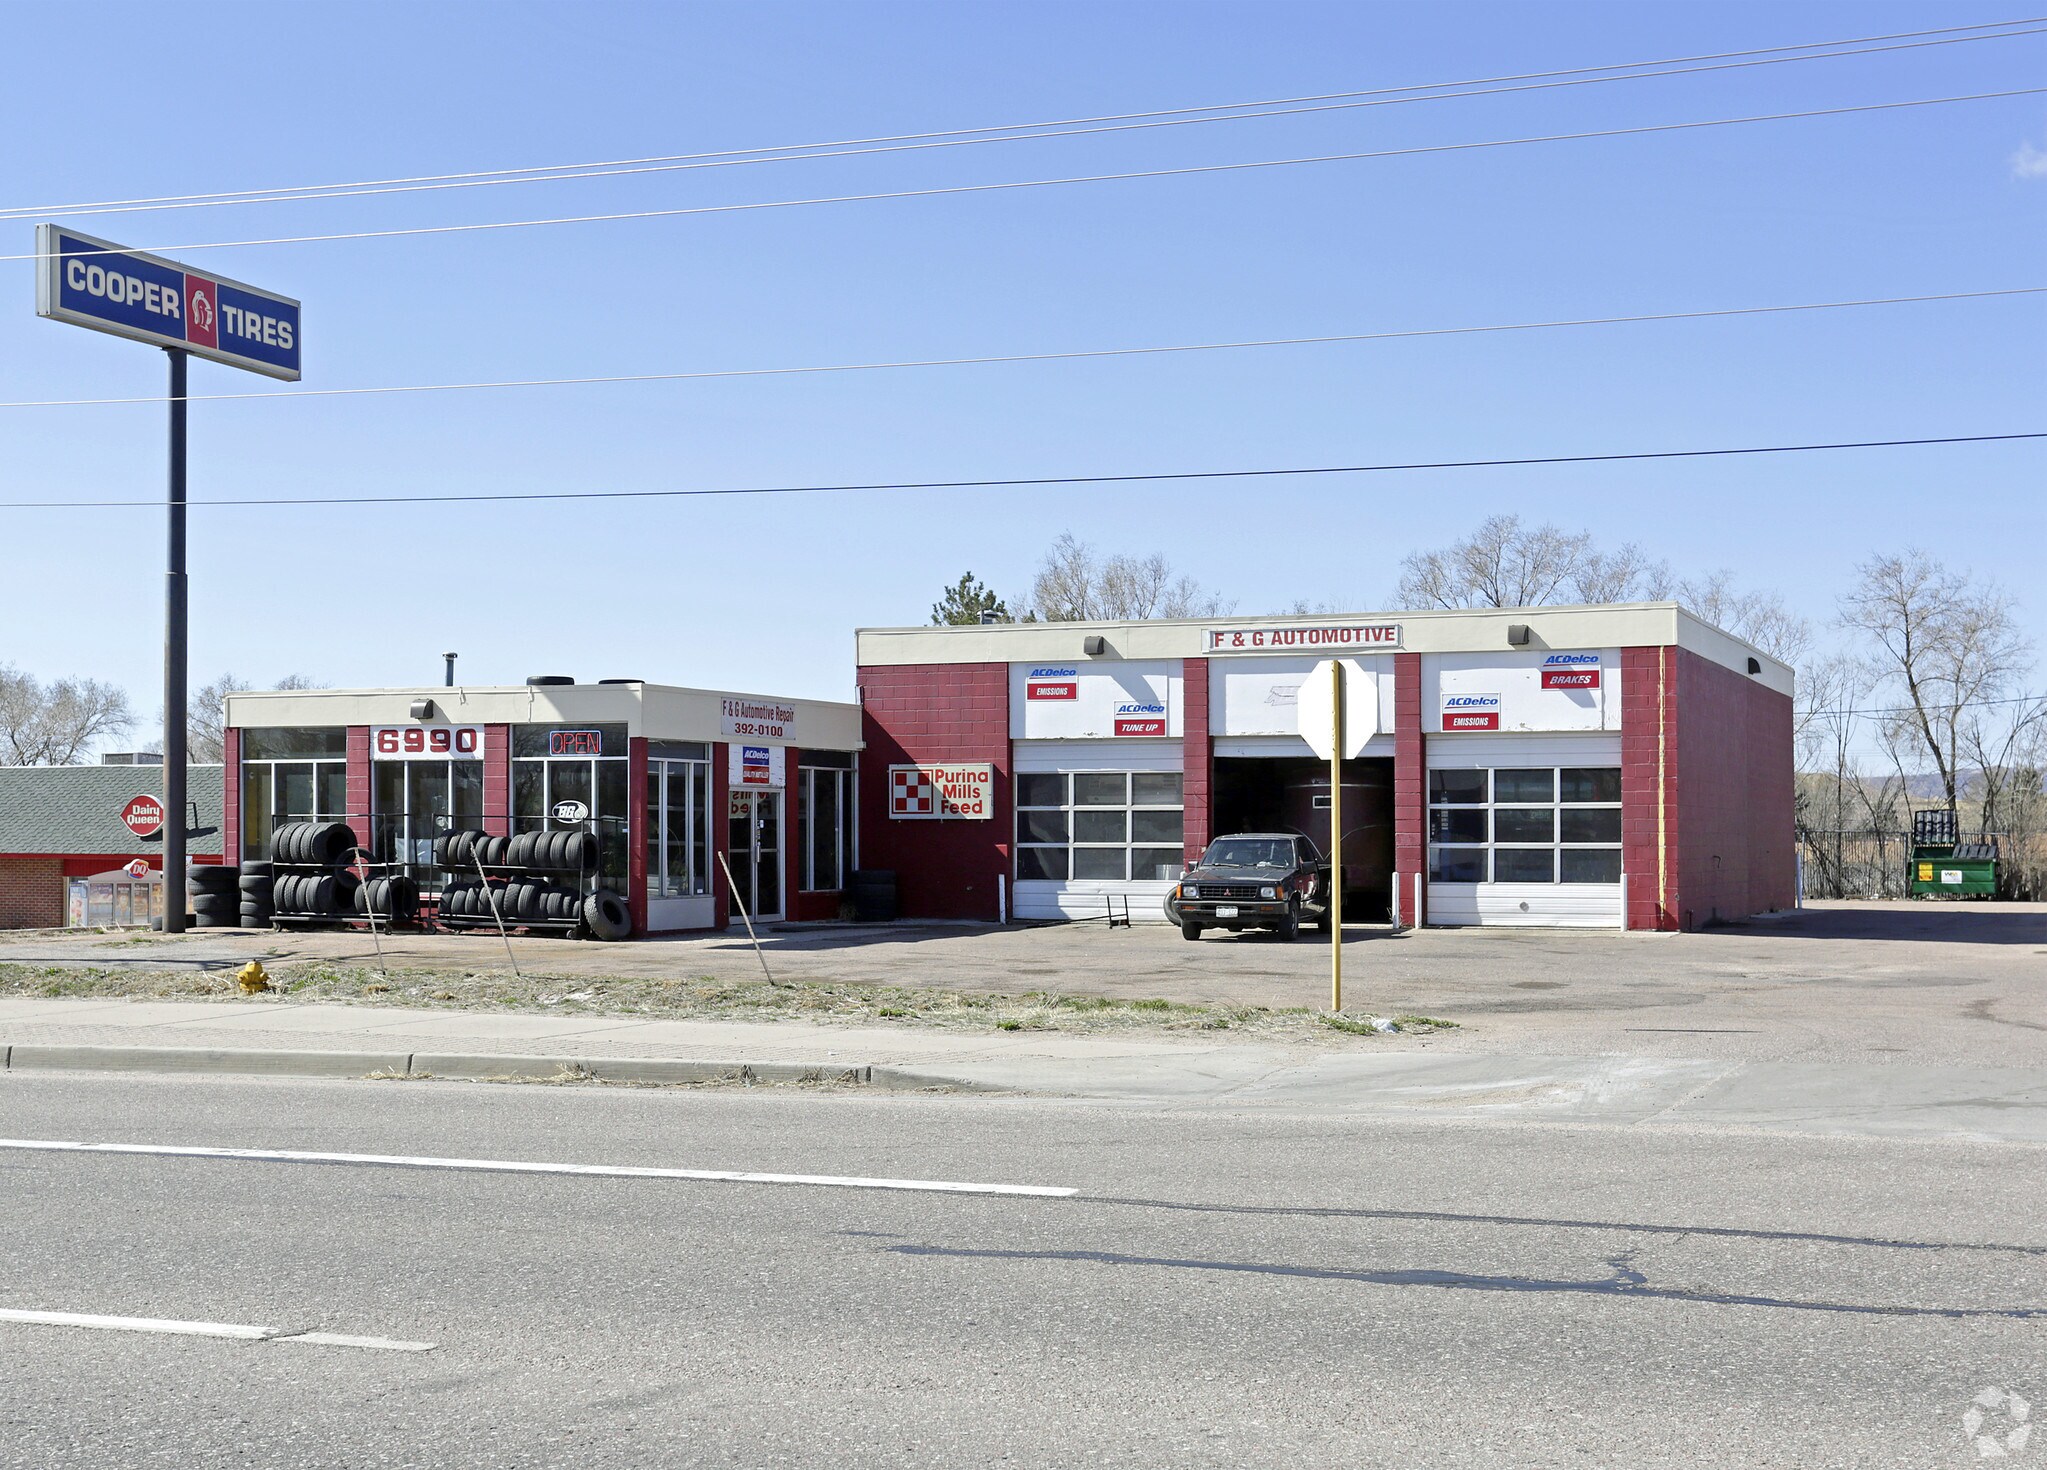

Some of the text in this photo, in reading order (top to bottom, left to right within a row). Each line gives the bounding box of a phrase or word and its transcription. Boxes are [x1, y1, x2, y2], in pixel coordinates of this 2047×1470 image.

[68, 259, 294, 350] COOPER TIRES
[1215, 627, 1396, 648] F & G AUTOMOTIVE
[1545, 655, 1599, 664] ACDelco
[1031, 668, 1077, 677] ACDelco
[1550, 675, 1592, 684] BRAKES
[1036, 687, 1068, 696] EMISSIONS
[1447, 697, 1499, 706] ACDelco
[723, 700, 794, 725] F & G Automotive Repair
[1118, 704, 1165, 713] ACDelco
[1453, 717, 1489, 726] EMISSIONS
[735, 722, 783, 737] 392-0100
[1122, 724, 1159, 732] TUNE UP
[378, 729, 478, 753] 6990
[551, 733, 599, 754] OPEN
[744, 750, 769, 759] ACDelco
[935, 769, 989, 783] Purina
[943, 784, 981, 799] Mills
[132, 804, 160, 816] Dairy
[941, 800, 983, 814] Feed
[127, 814, 160, 826] Queen
[132, 864, 146, 875] DQ
